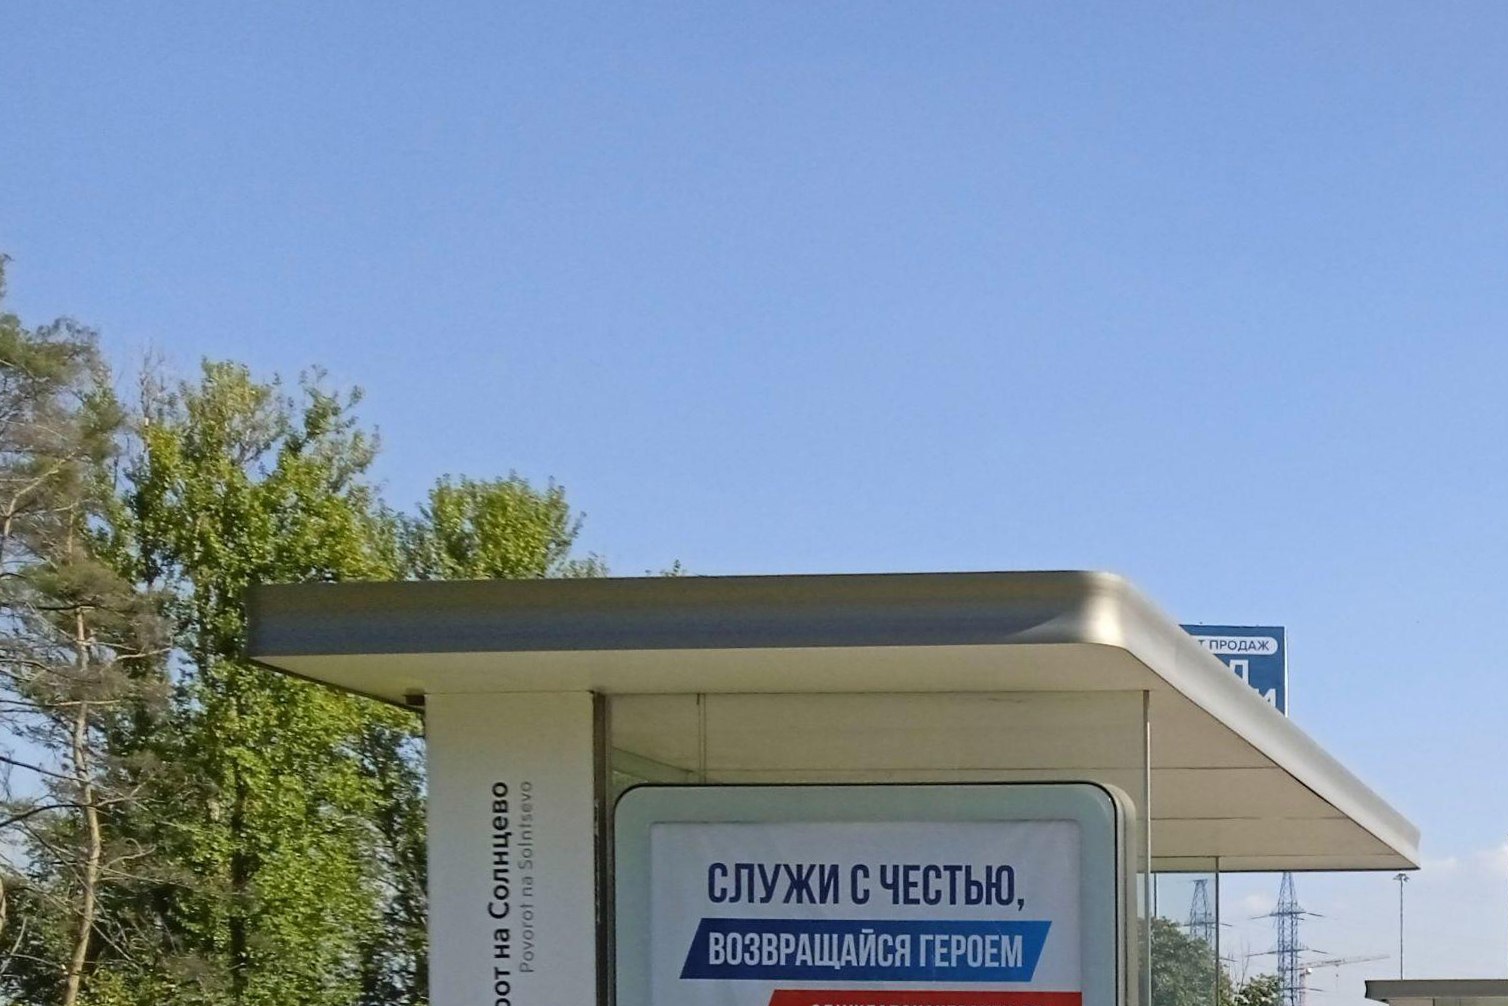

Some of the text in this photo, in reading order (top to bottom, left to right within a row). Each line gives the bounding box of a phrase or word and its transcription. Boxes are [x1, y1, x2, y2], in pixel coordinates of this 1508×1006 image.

[1209, 640, 1269, 652] ПРОДАЖ
[488, 782, 512, 919] Солнцево
[517, 780, 535, 973] Povorot na Solntsevo
[707, 862, 1025, 911] СЛУЖИ С ЧЕСТЬЮ,
[494, 928, 511, 959] на
[708, 929, 1023, 970] ВОЗВРАЩАЙСЯ ГЕРОЕМ
